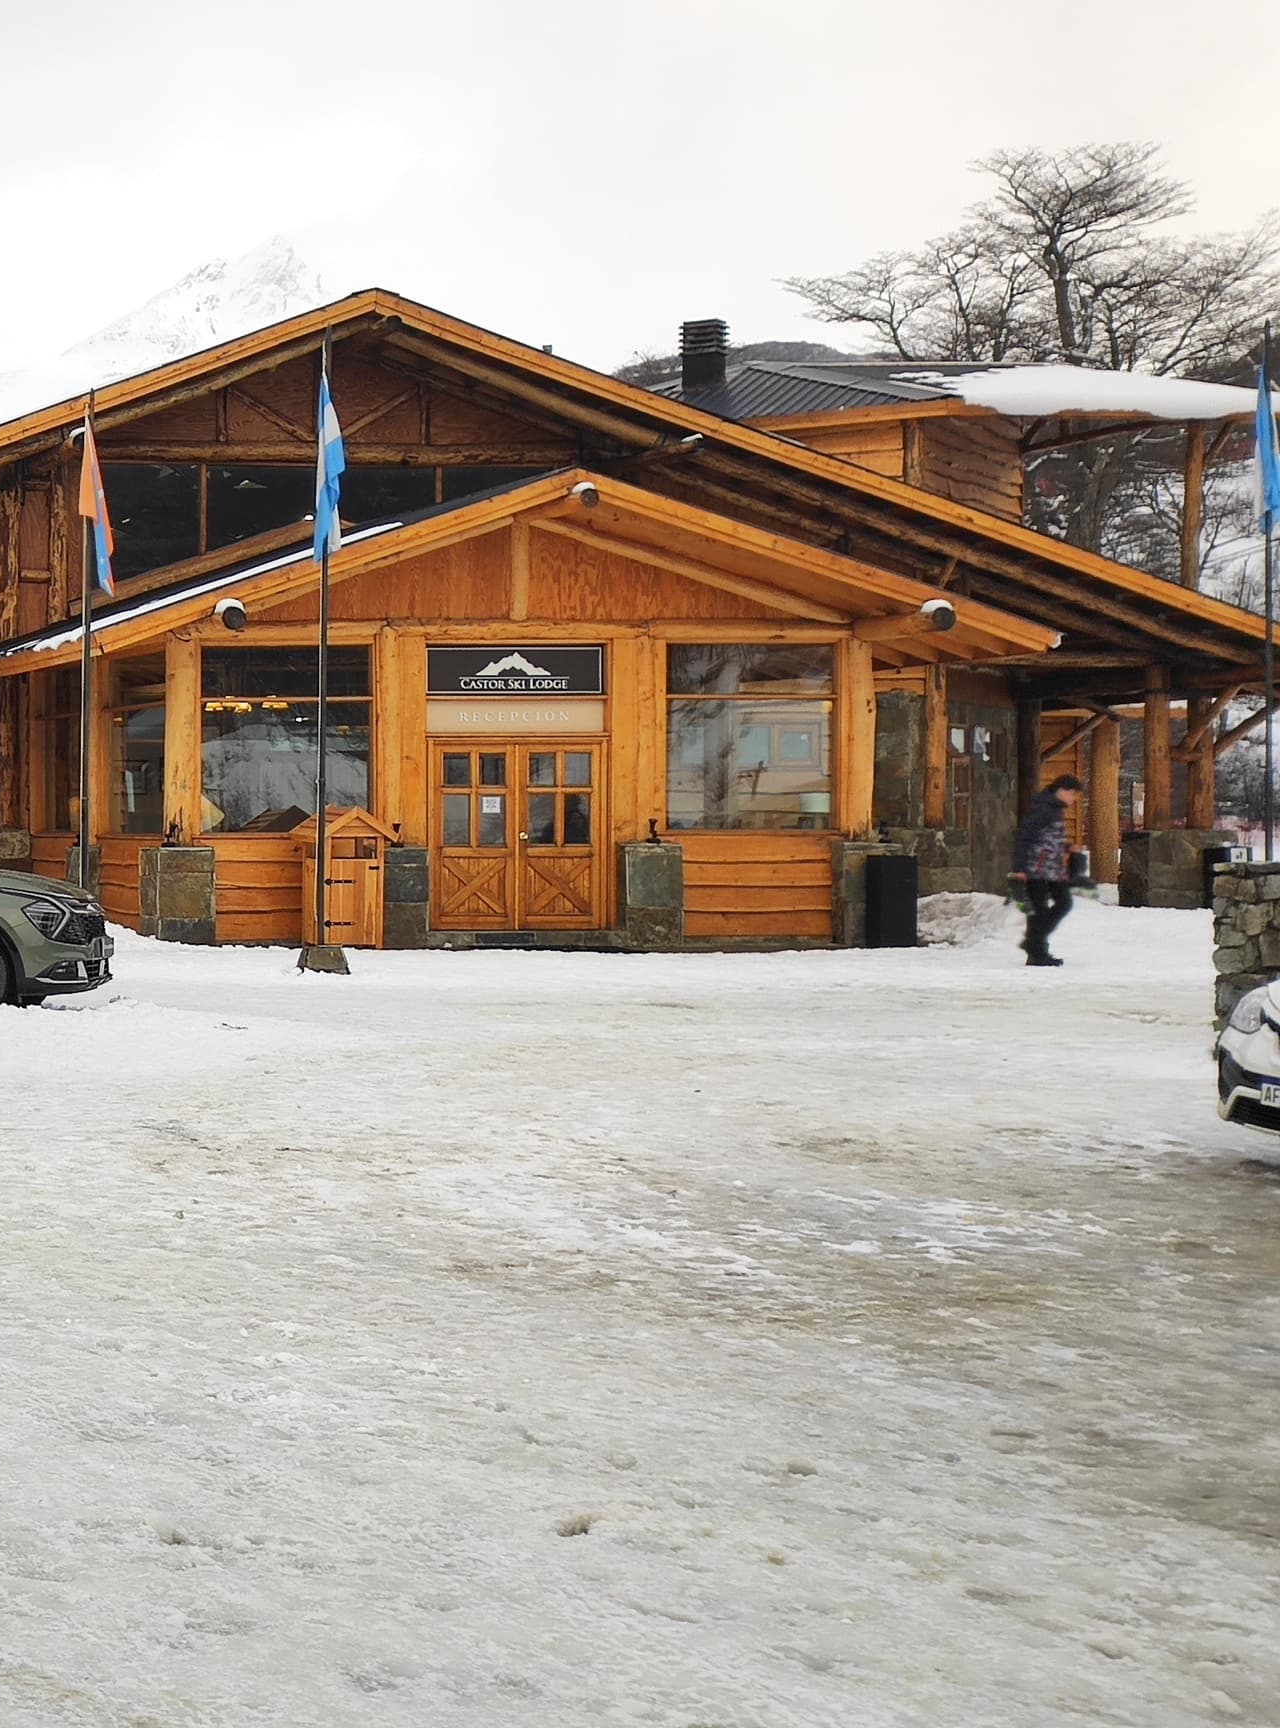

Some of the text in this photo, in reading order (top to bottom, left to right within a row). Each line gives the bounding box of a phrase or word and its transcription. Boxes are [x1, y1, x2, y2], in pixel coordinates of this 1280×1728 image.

[460, 678, 568, 690] CASTOR SKI LODGE
